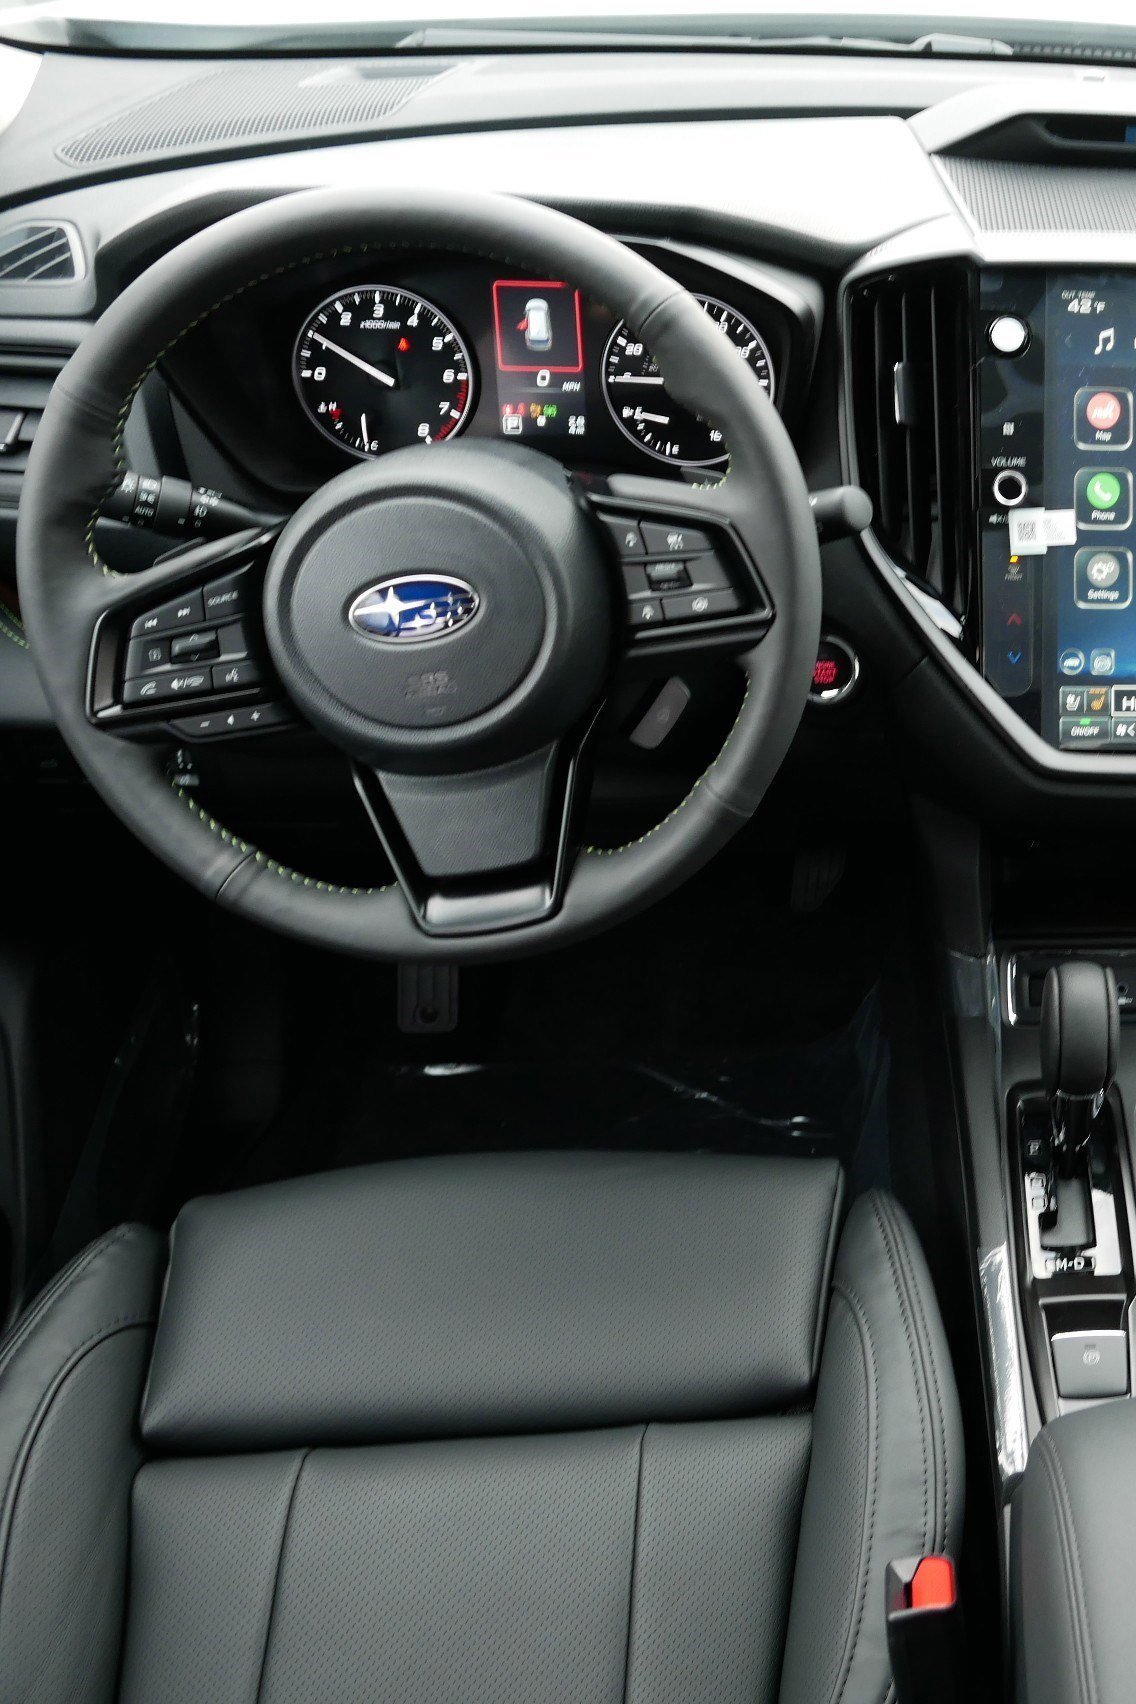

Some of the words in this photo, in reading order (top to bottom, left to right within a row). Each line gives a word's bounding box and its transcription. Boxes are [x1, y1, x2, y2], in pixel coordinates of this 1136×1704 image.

[373, 303, 384, 318] 3
[340, 311, 352, 326] 2
[407, 313, 419, 327] 4
[432, 337, 444, 350] 5
[313, 367, 326, 381] 0
[442, 369, 455, 383] 6
[537, 369, 550, 387] 0
[562, 381, 580, 391] MPH
[439, 401, 450, 415] 7
[417, 423, 430, 437] 8
[1095, 431, 1112, 442] Map
[991, 456, 1027, 467] VOLUME
[1091, 509, 1115, 521] Phone
[1087, 588, 1119, 601] Settings
